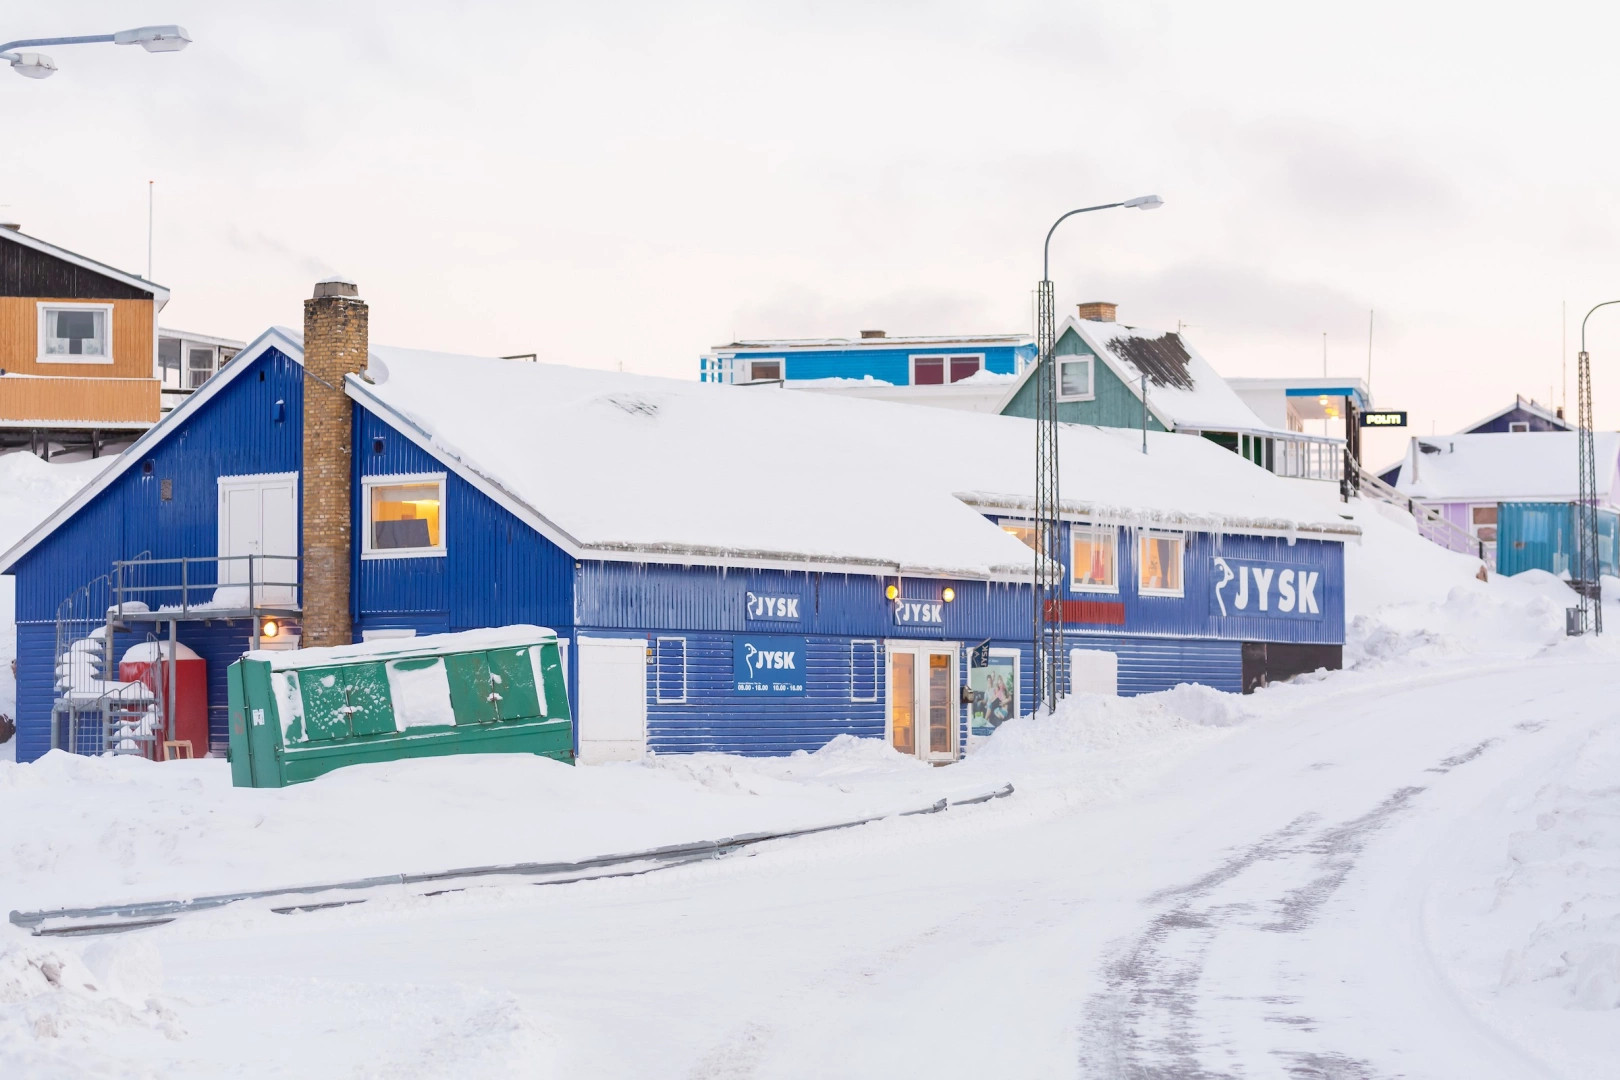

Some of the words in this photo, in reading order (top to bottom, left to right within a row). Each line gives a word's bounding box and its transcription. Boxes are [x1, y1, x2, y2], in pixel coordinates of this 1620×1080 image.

[1234, 566, 1320, 614] JYSK
[755, 596, 799, 618] JYSK
[902, 603, 942, 623] JYSK
[755, 650, 796, 670] JYSK
[980, 645, 989, 667] JYSK
